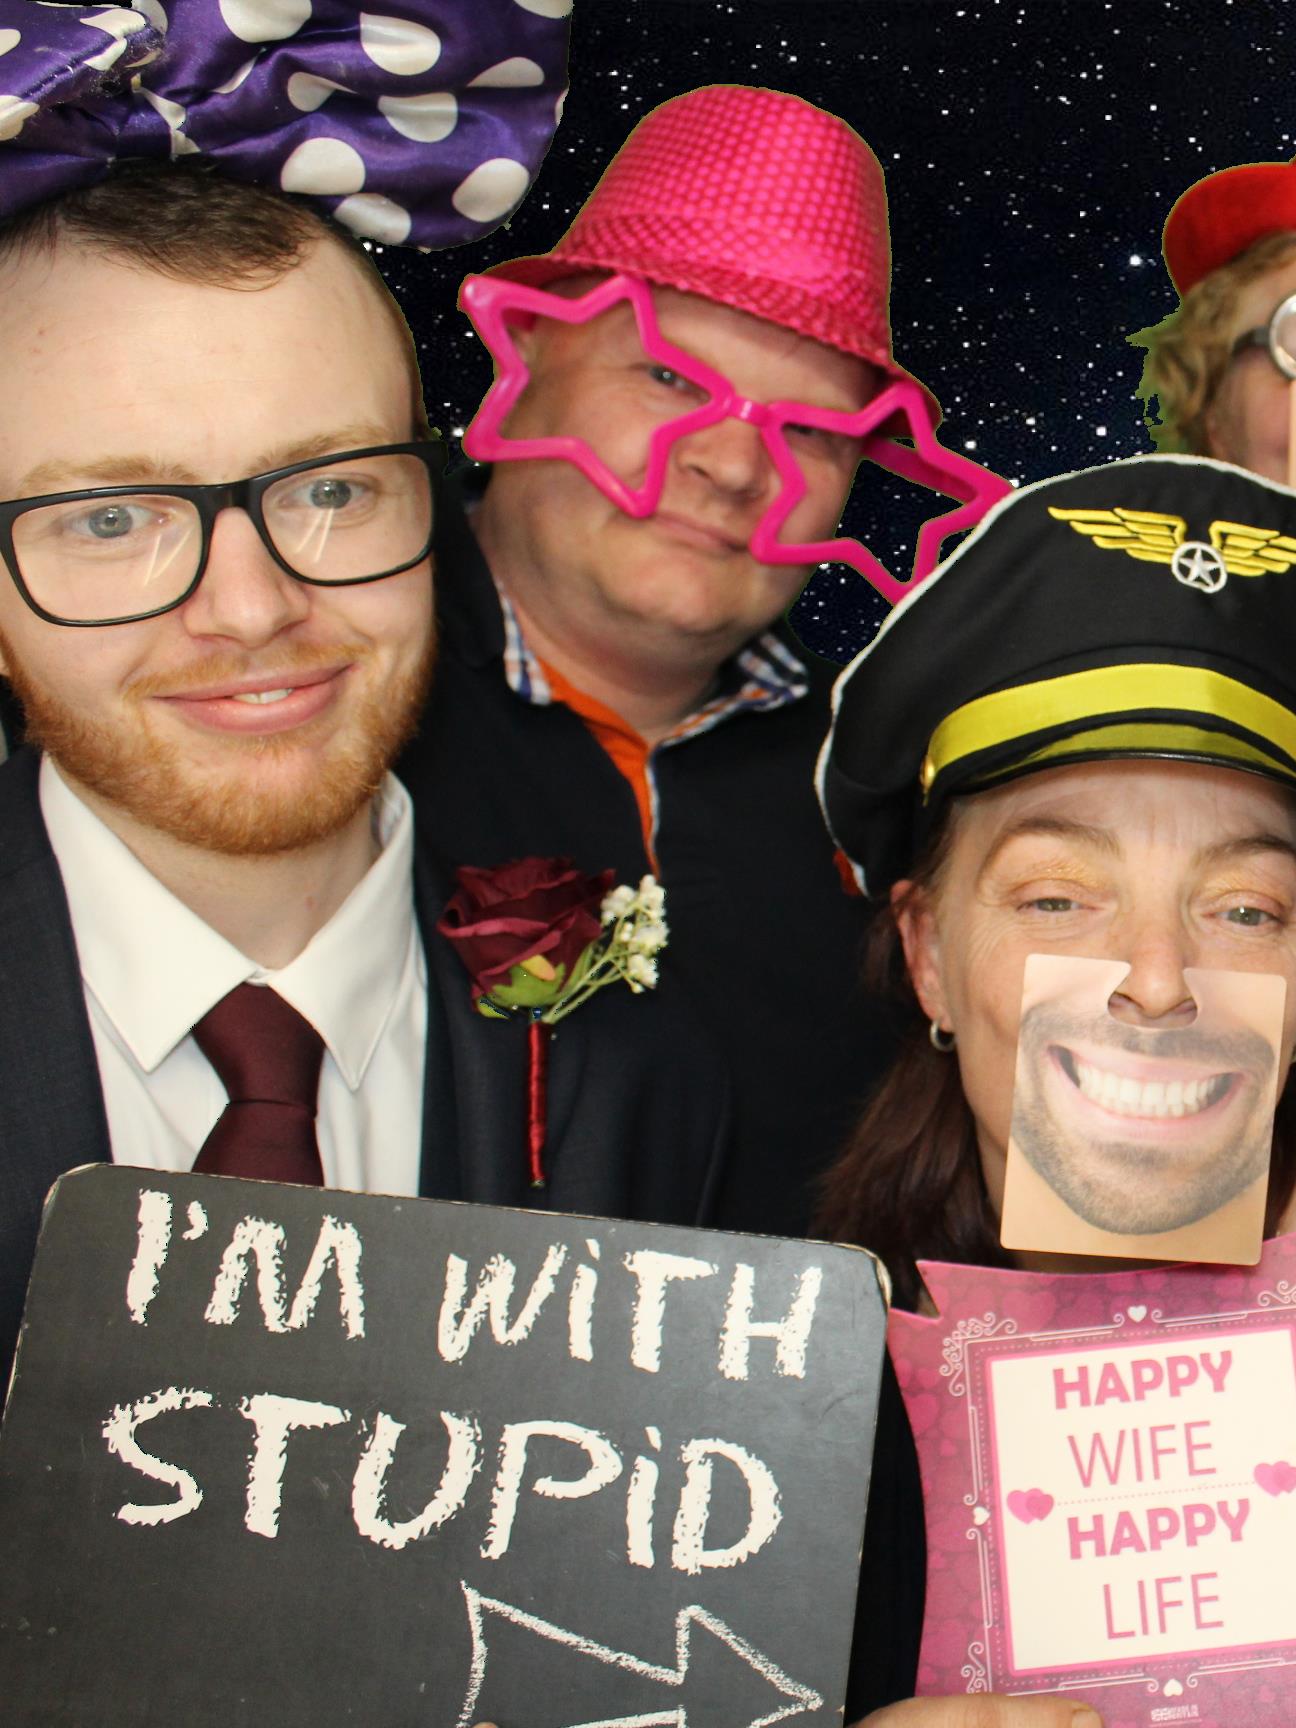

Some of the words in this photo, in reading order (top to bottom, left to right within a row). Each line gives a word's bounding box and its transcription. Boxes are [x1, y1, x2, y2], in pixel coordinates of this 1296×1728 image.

[126, 1188, 366, 1340] I'M
[1052, 1350, 1233, 1410] HAPPY
[1067, 1420, 1217, 1488] WIFE
[1066, 1498, 1251, 1560] HAPPY
[1102, 1571, 1224, 1640] LIFE
